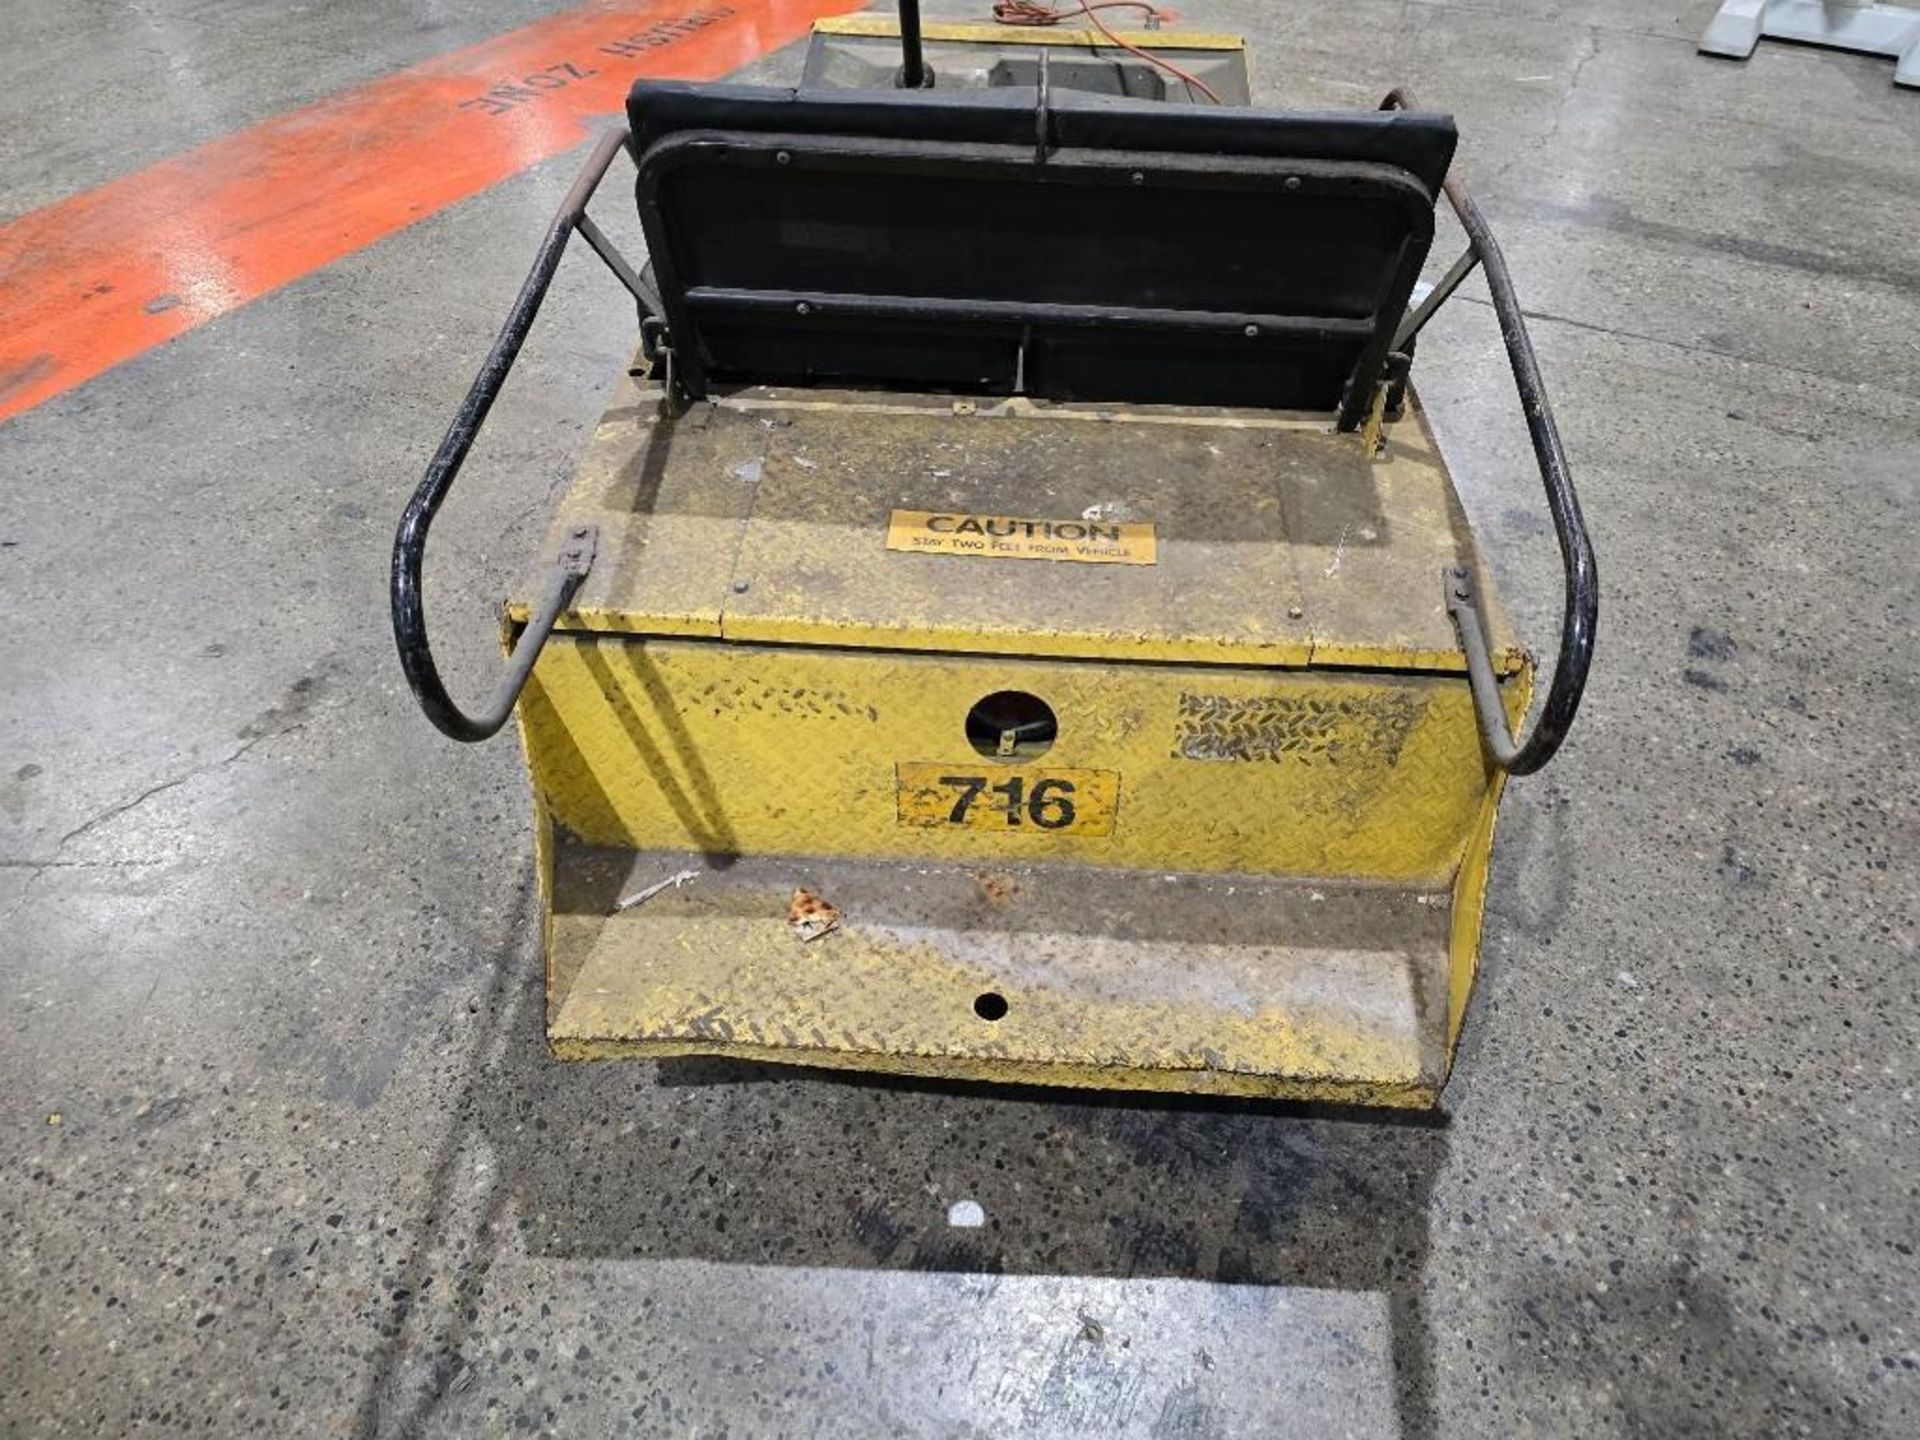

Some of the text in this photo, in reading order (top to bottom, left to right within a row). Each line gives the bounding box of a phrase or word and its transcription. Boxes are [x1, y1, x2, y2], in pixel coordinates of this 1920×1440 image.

[458, 62, 597, 115] ZONE
[913, 537, 1131, 557] STAY TWO FEET FROM VEHICLE
[926, 516, 1119, 541] CAUTION
[938, 776, 1076, 829] 716
